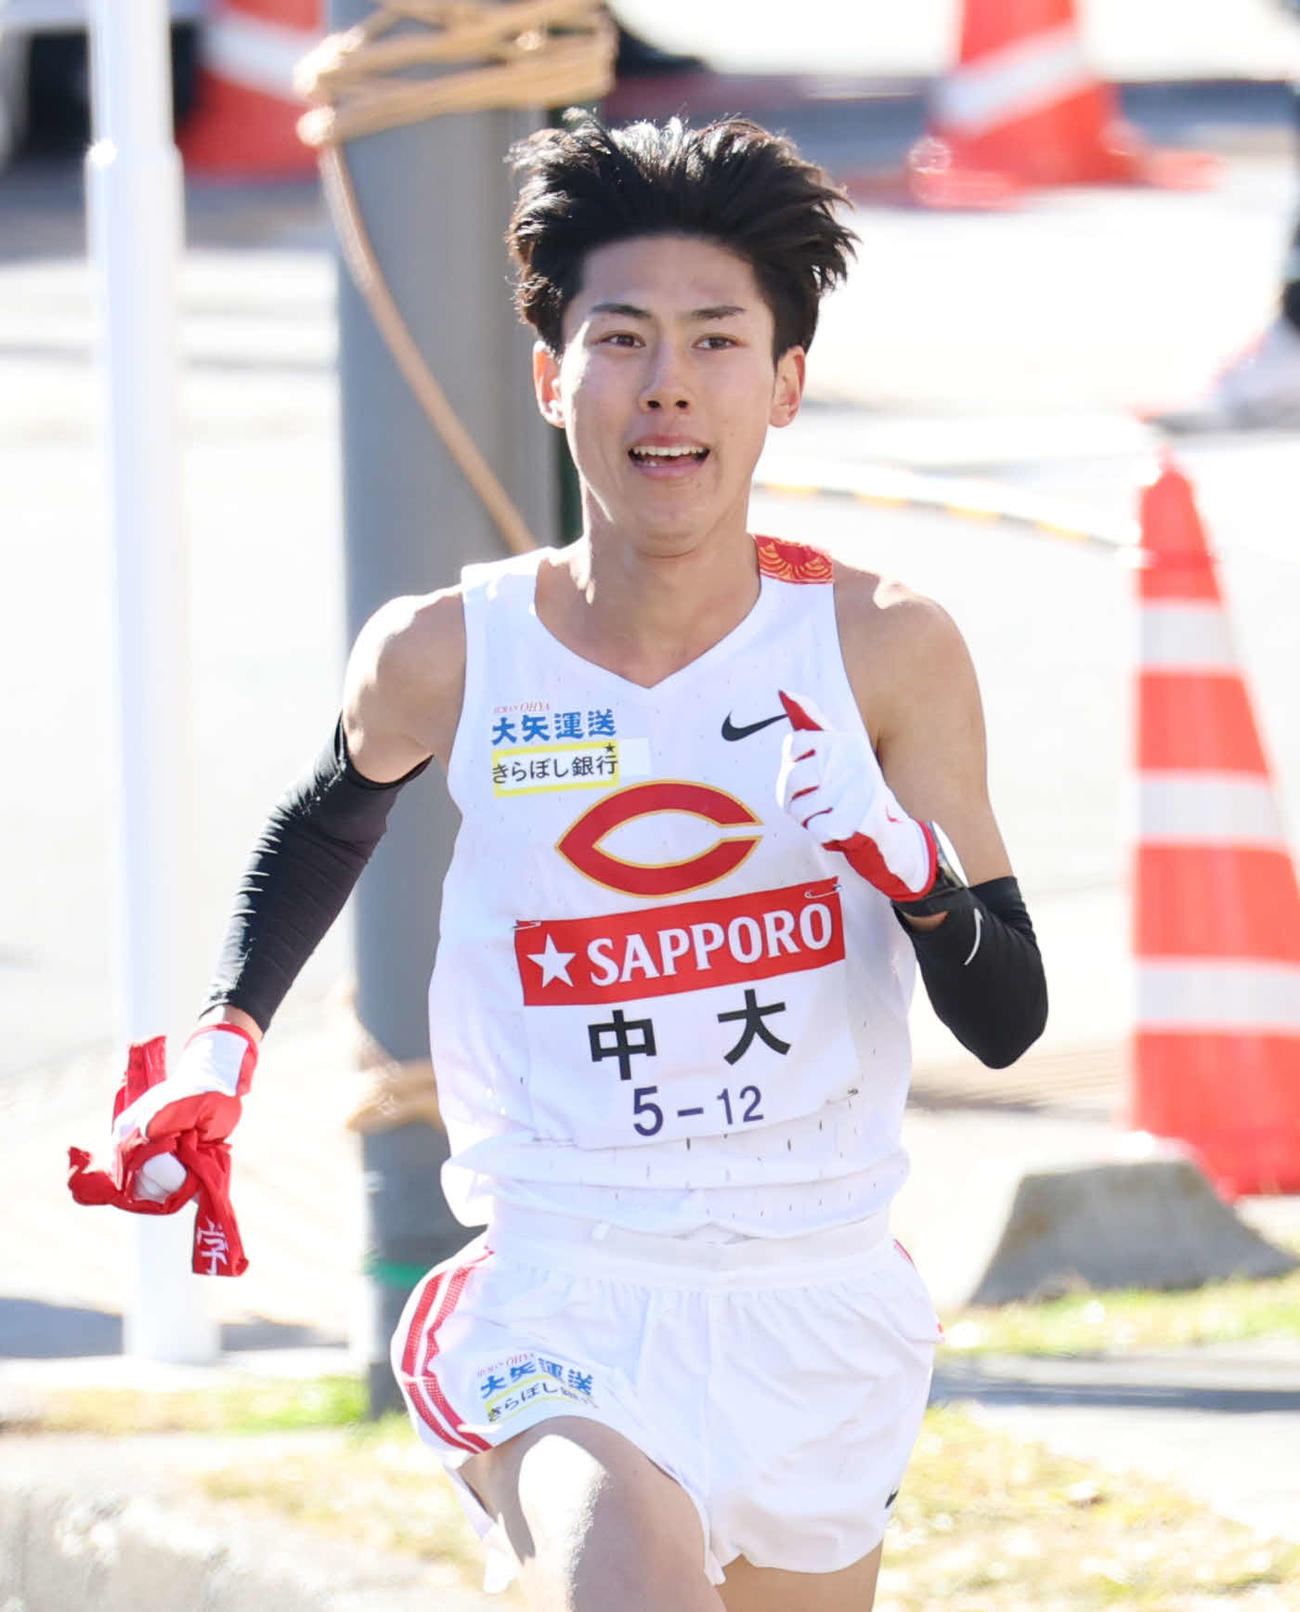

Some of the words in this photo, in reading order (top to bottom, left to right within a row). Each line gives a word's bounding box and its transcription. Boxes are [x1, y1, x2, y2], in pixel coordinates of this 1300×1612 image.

[491, 708, 617, 746] 大矢運送
[491, 755, 618, 784] きらぼし銀行
[555, 778, 764, 898] C
[586, 902, 833, 987] SAPPORO
